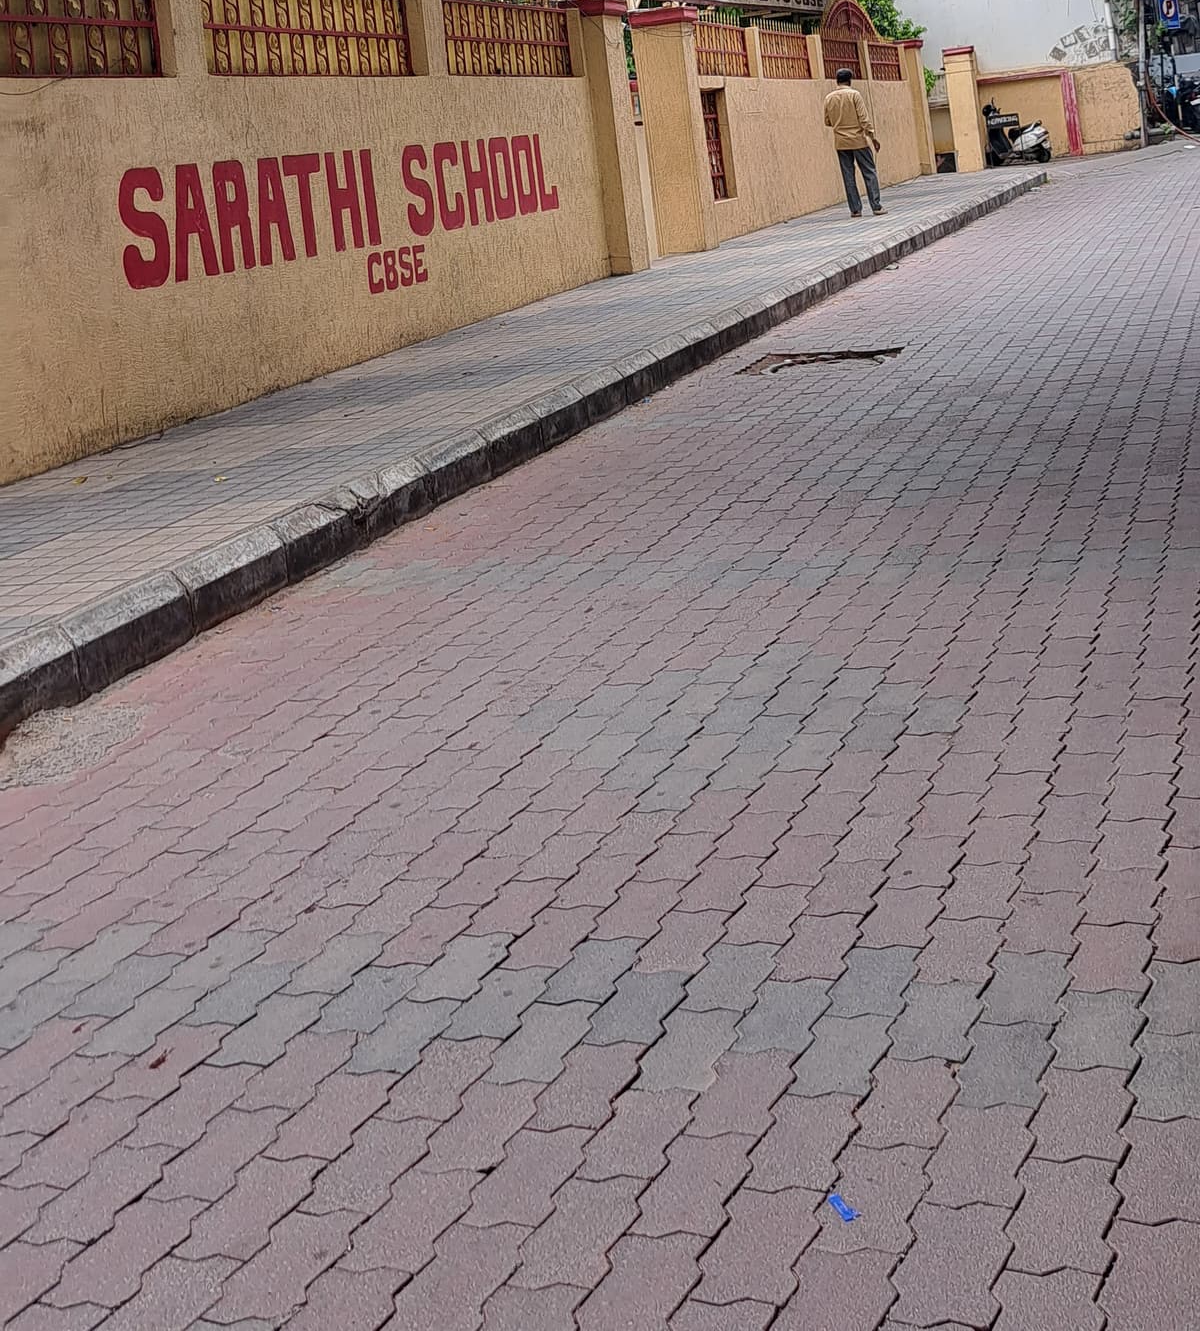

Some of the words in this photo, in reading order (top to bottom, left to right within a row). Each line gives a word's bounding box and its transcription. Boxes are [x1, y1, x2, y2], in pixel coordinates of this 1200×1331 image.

[118, 149, 381, 289] SARATHI
[401, 134, 559, 236] SCHOOL
[367, 244, 428, 294] CBSE
